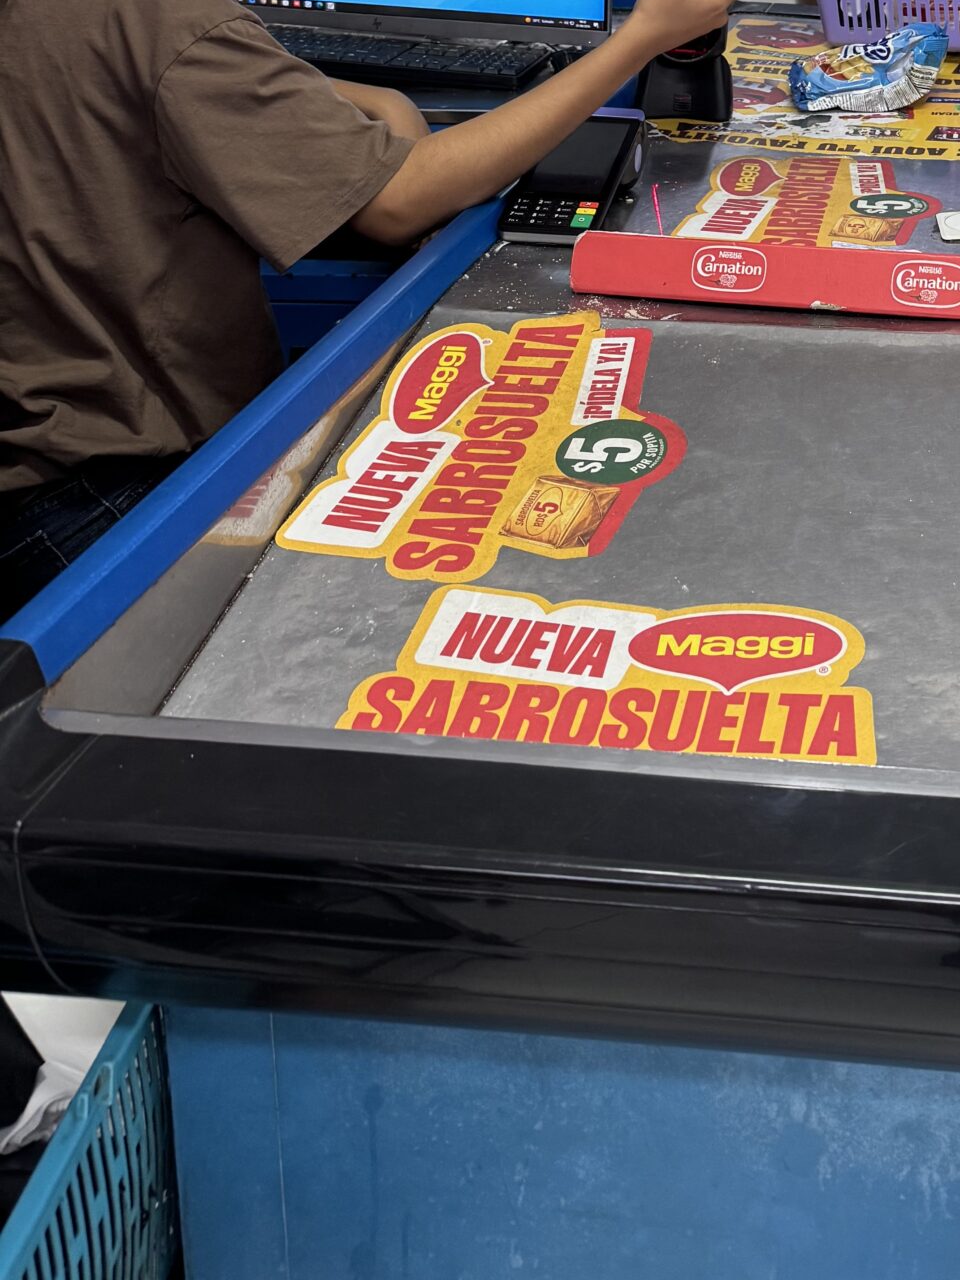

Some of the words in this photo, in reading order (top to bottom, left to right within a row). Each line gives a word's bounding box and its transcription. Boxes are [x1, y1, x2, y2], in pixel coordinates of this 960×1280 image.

[816, 142, 861, 154] TU
[870, 145, 948, 157] AQUÍ
[734, 163, 761, 192] Maggi
[700, 198, 769, 235] NUEVA
[760, 158, 841, 247] SABROSUELTA
[856, 200, 912, 214] $5
[697, 254, 762, 278] Carnation
[718, 250, 743, 260] Nestlé
[918, 265, 943, 275] Nestlé
[596, 343, 629, 365] YA!
[408, 345, 467, 422] Maggi
[580, 368, 622, 420] ¡PÍDELA
[394, 323, 585, 573] SABROSUELTA
[563, 437, 643, 474] $5
[629, 458, 653, 474] POR
[642, 431, 659, 458] SOPITA
[321, 440, 444, 533] NUEVA
[515, 489, 541, 526] SABROSUELTA
[440, 611, 618, 678] NUEVA
[655, 632, 815, 661] Maggi
[350, 676, 859, 757] SABROSUELTA
